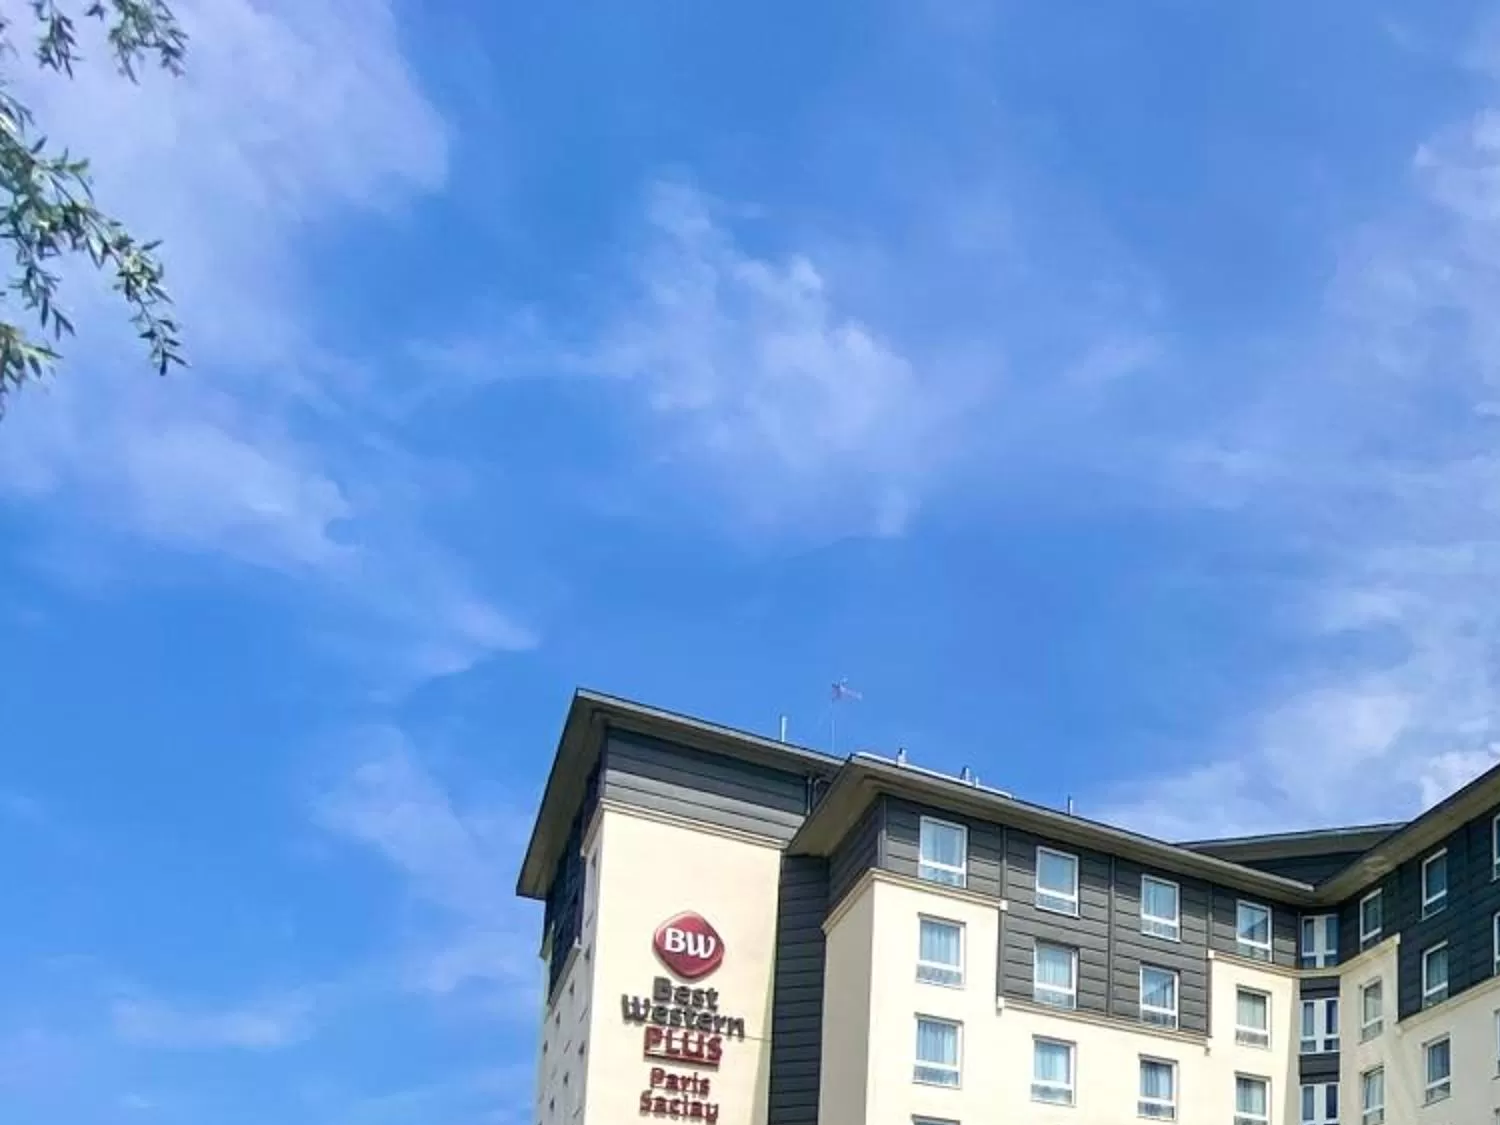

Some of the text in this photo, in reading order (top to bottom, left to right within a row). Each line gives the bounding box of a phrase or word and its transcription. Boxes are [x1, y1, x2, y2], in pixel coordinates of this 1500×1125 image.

[664, 928, 716, 959] BW
[653, 976, 719, 1010] Best
[621, 994, 745, 1038] Western
[644, 1026, 722, 1061] PLUS
[650, 1067, 710, 1096] Paris
[640, 1090, 719, 1125] Saclay
